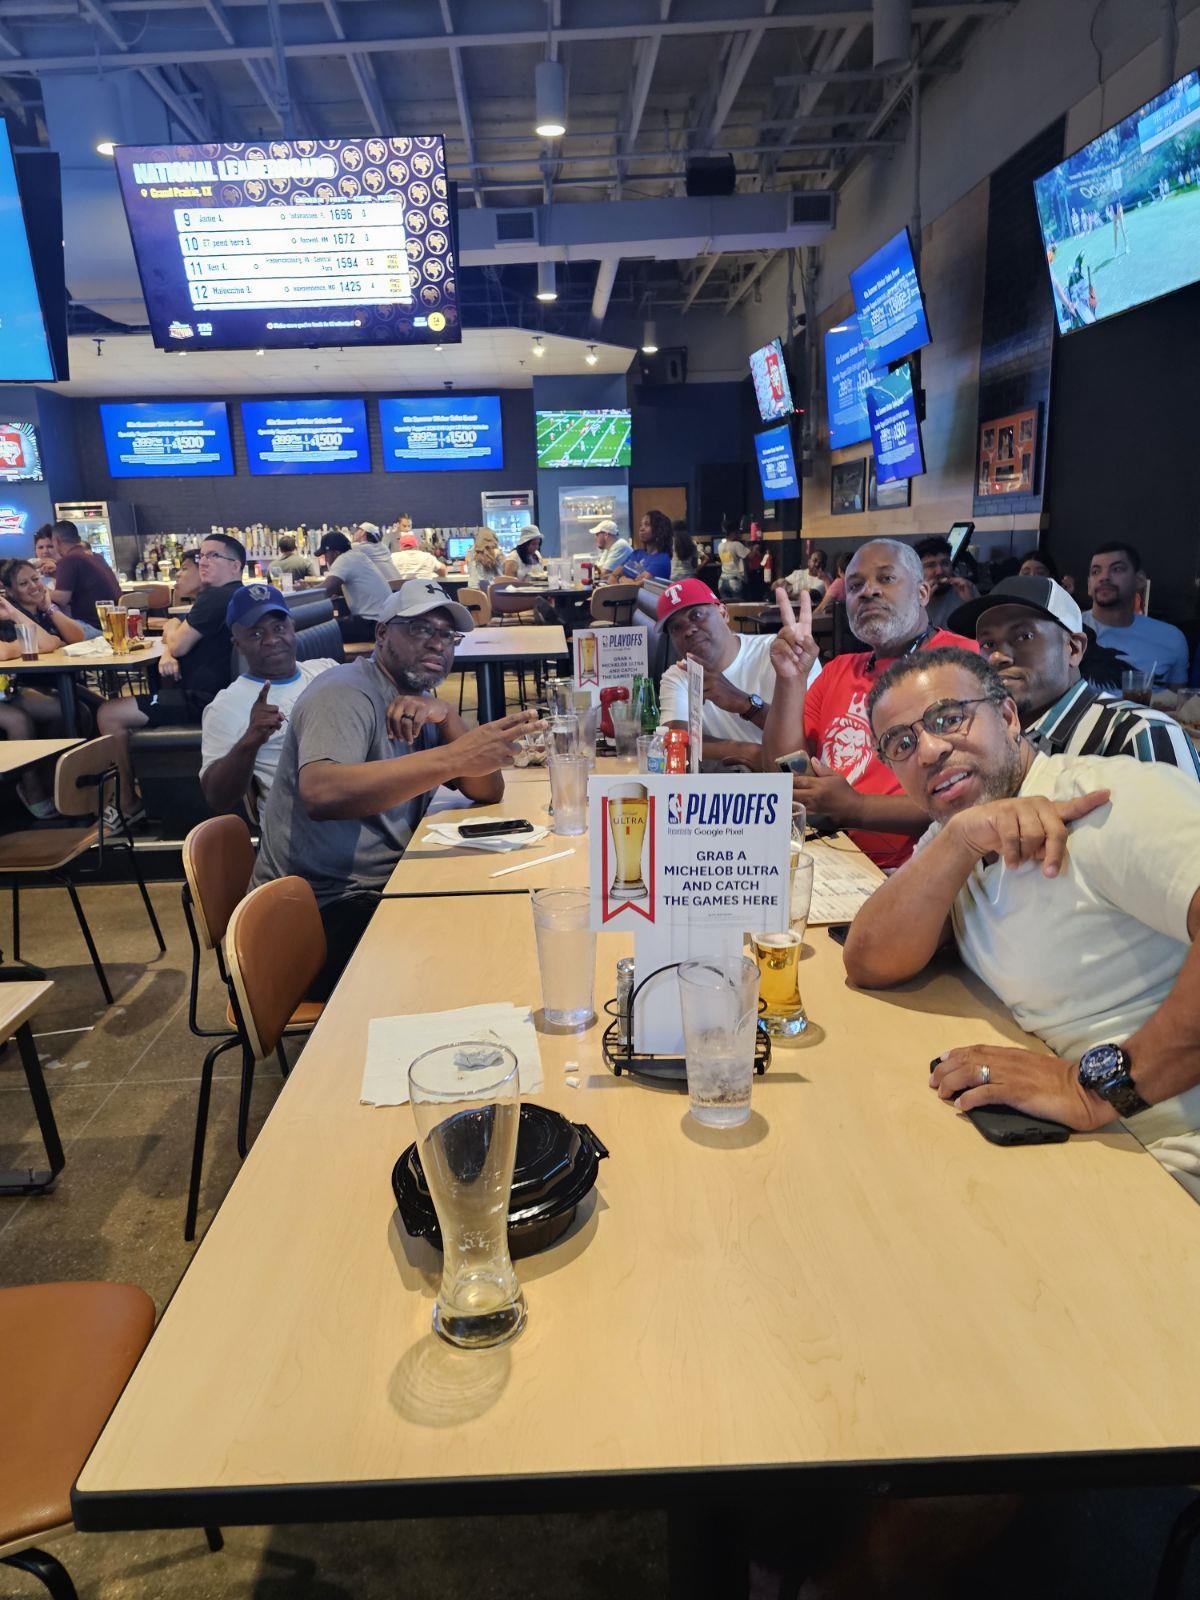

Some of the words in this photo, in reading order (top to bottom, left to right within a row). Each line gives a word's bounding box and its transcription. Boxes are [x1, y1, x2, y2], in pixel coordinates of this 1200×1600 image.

[183, 212, 191, 227] 9
[330, 209, 353, 220] 1696
[184, 237, 199, 250] 10
[333, 233, 355, 244] 1672
[336, 257, 359, 268] 1594
[190, 262, 203, 275] 11
[195, 285, 208, 299] 12
[340, 281, 362, 292] 1425
[665, 584, 683, 605] T
[609, 633, 643, 647] PLAYOFFS
[686, 793, 779, 825] PLAYOFFS
[613, 817, 644, 825] ULTRA
[694, 828, 724, 837] Google
[725, 828, 744, 836] Pixel
[696, 850, 734, 861] GRAB
[737, 850, 747, 861] A
[664, 865, 734, 876] MICHELOB
[737, 865, 779, 876] ULTRA
[682, 881, 712, 891] AND
[715, 880, 759, 891] CATCH
[663, 895, 689, 906] THE
[692, 895, 739, 906] GAMES
[743, 895, 778, 906] HERE
